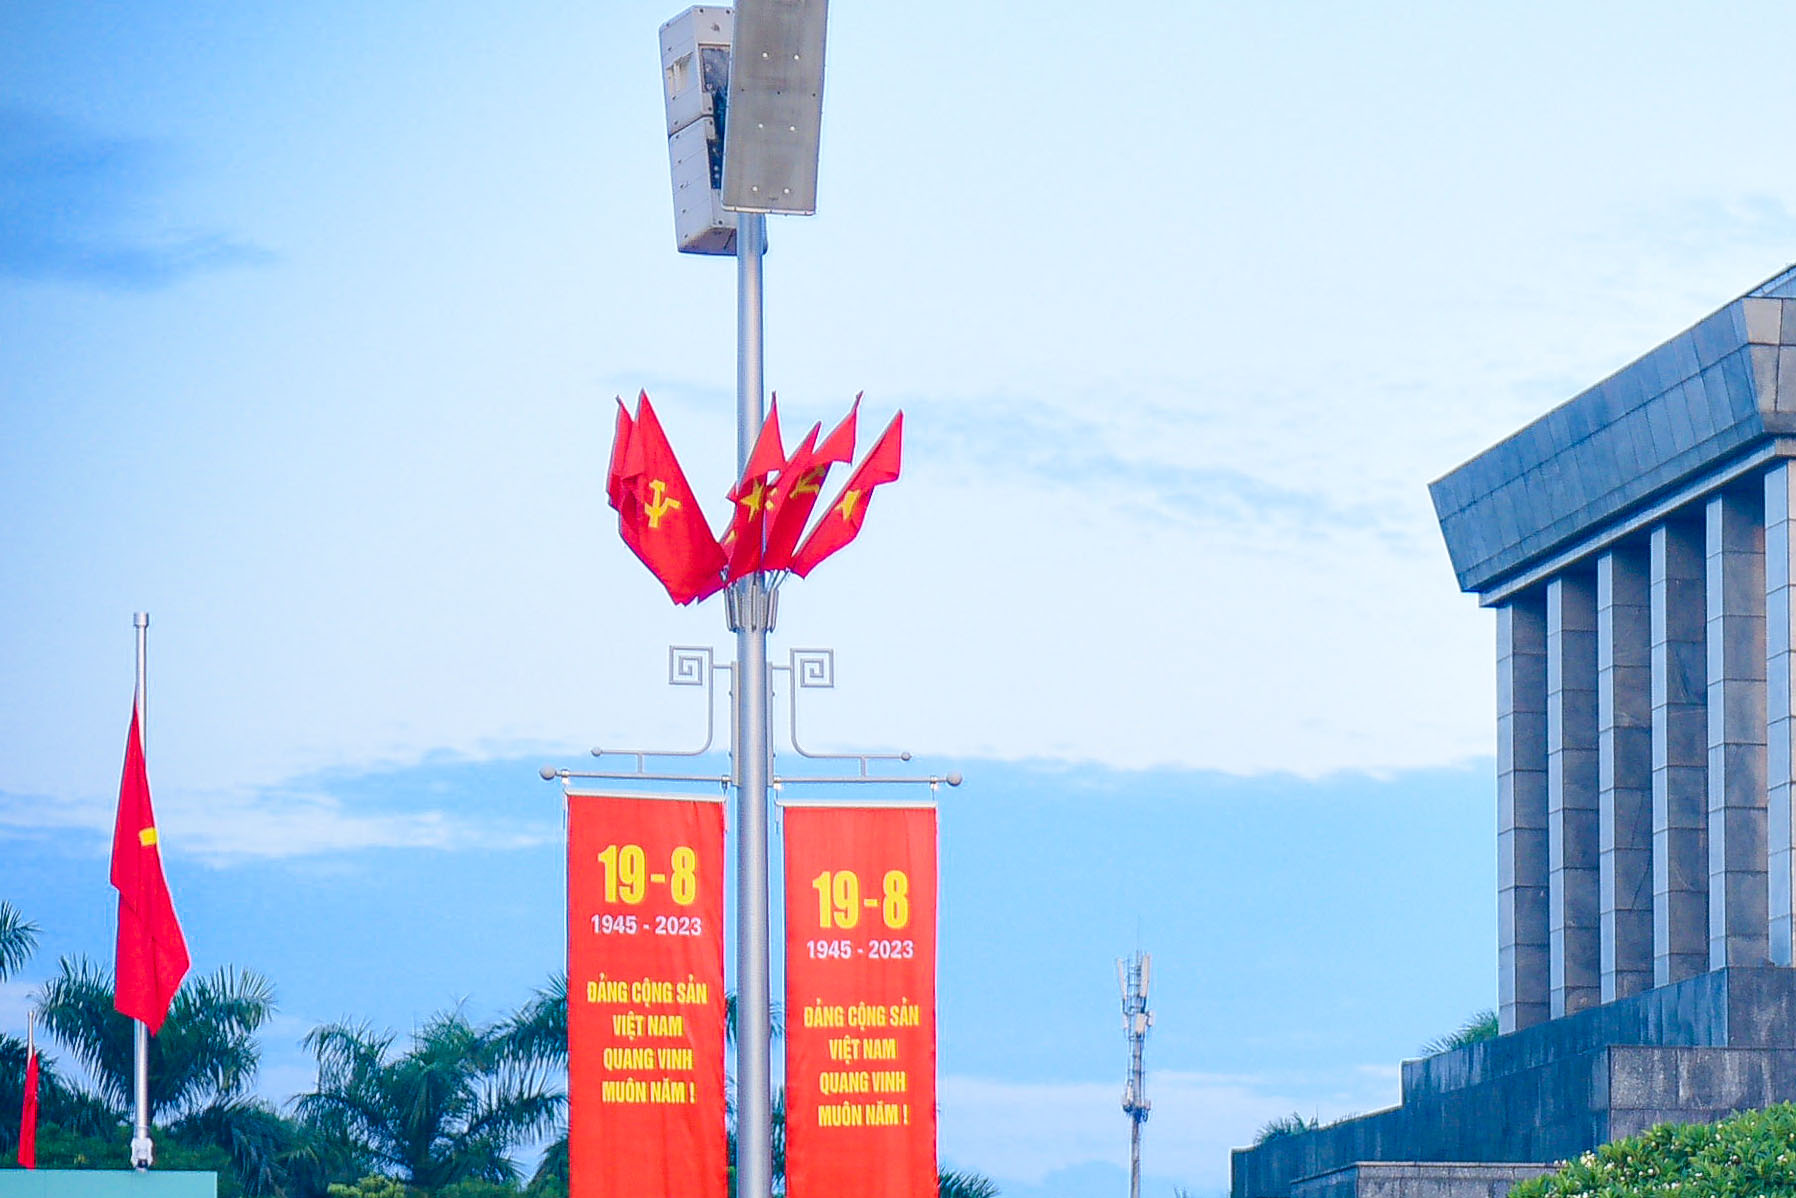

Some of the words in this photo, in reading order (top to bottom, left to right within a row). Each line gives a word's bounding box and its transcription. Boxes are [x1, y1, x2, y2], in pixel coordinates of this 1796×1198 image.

[598, 844, 697, 905] 19-8
[812, 870, 909, 929] 19-8
[591, 914, 637, 935] 1945
[655, 915, 702, 936] 2023
[807, 940, 851, 959] 1945
[868, 939, 914, 959] 2023
[587, 972, 629, 1004] ĐẢNG
[632, 977, 673, 1008] CỘNG
[676, 974, 708, 1005] SẢN
[613, 1010, 645, 1041] VIỆT
[648, 1015, 683, 1037] NAM
[803, 998, 844, 1028] ĐẢNG
[848, 1001, 886, 1031] CỘNG
[889, 997, 919, 1027] SẢN
[603, 1047, 654, 1071] QUANG
[657, 1048, 693, 1070] VINH
[828, 1035, 860, 1065] VIỆT
[863, 1039, 897, 1060] NAM
[602, 1077, 647, 1103] MUÔN
[650, 1077, 685, 1104] NĂM
[819, 1071, 869, 1095] QUANG
[871, 1071, 906, 1093] VINH
[818, 1101, 862, 1127] MUÔN
[865, 1101, 899, 1126] NĂM
